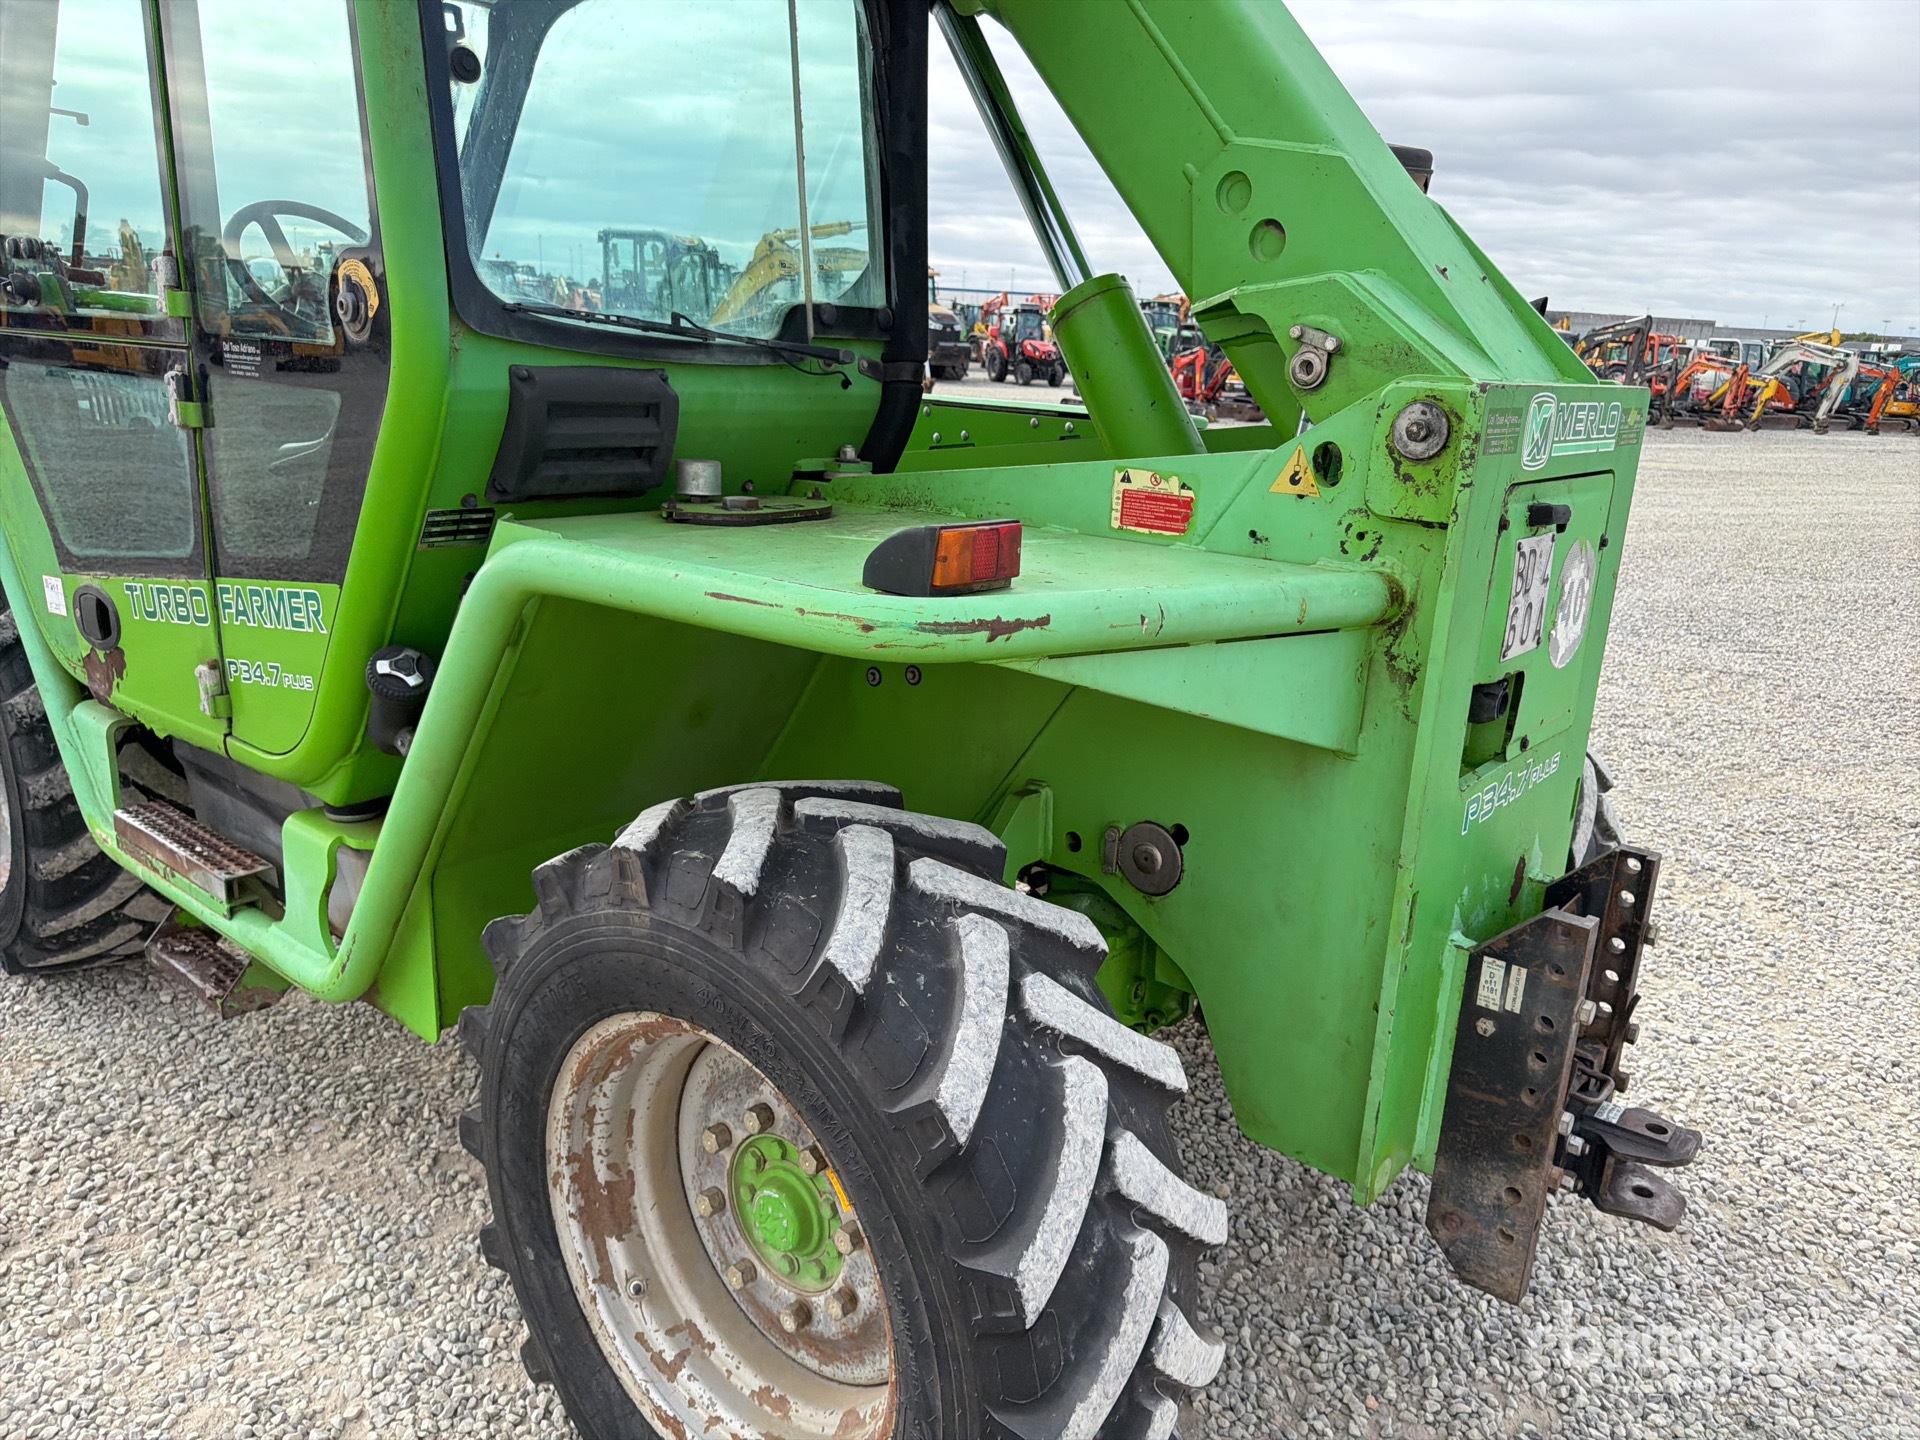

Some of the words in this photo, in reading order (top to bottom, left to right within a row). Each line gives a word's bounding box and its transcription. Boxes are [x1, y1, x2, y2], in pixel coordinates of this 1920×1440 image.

[1554, 402, 1621, 440] MERLO
[1512, 549, 1537, 599] BD
[123, 582, 210, 626] TURBO
[217, 584, 327, 634] FARMER
[226, 659, 281, 686] P34.7
[283, 673, 313, 691] PLUS
[1461, 758, 1533, 836] P34.7
[1529, 751, 1561, 789] PLUS
